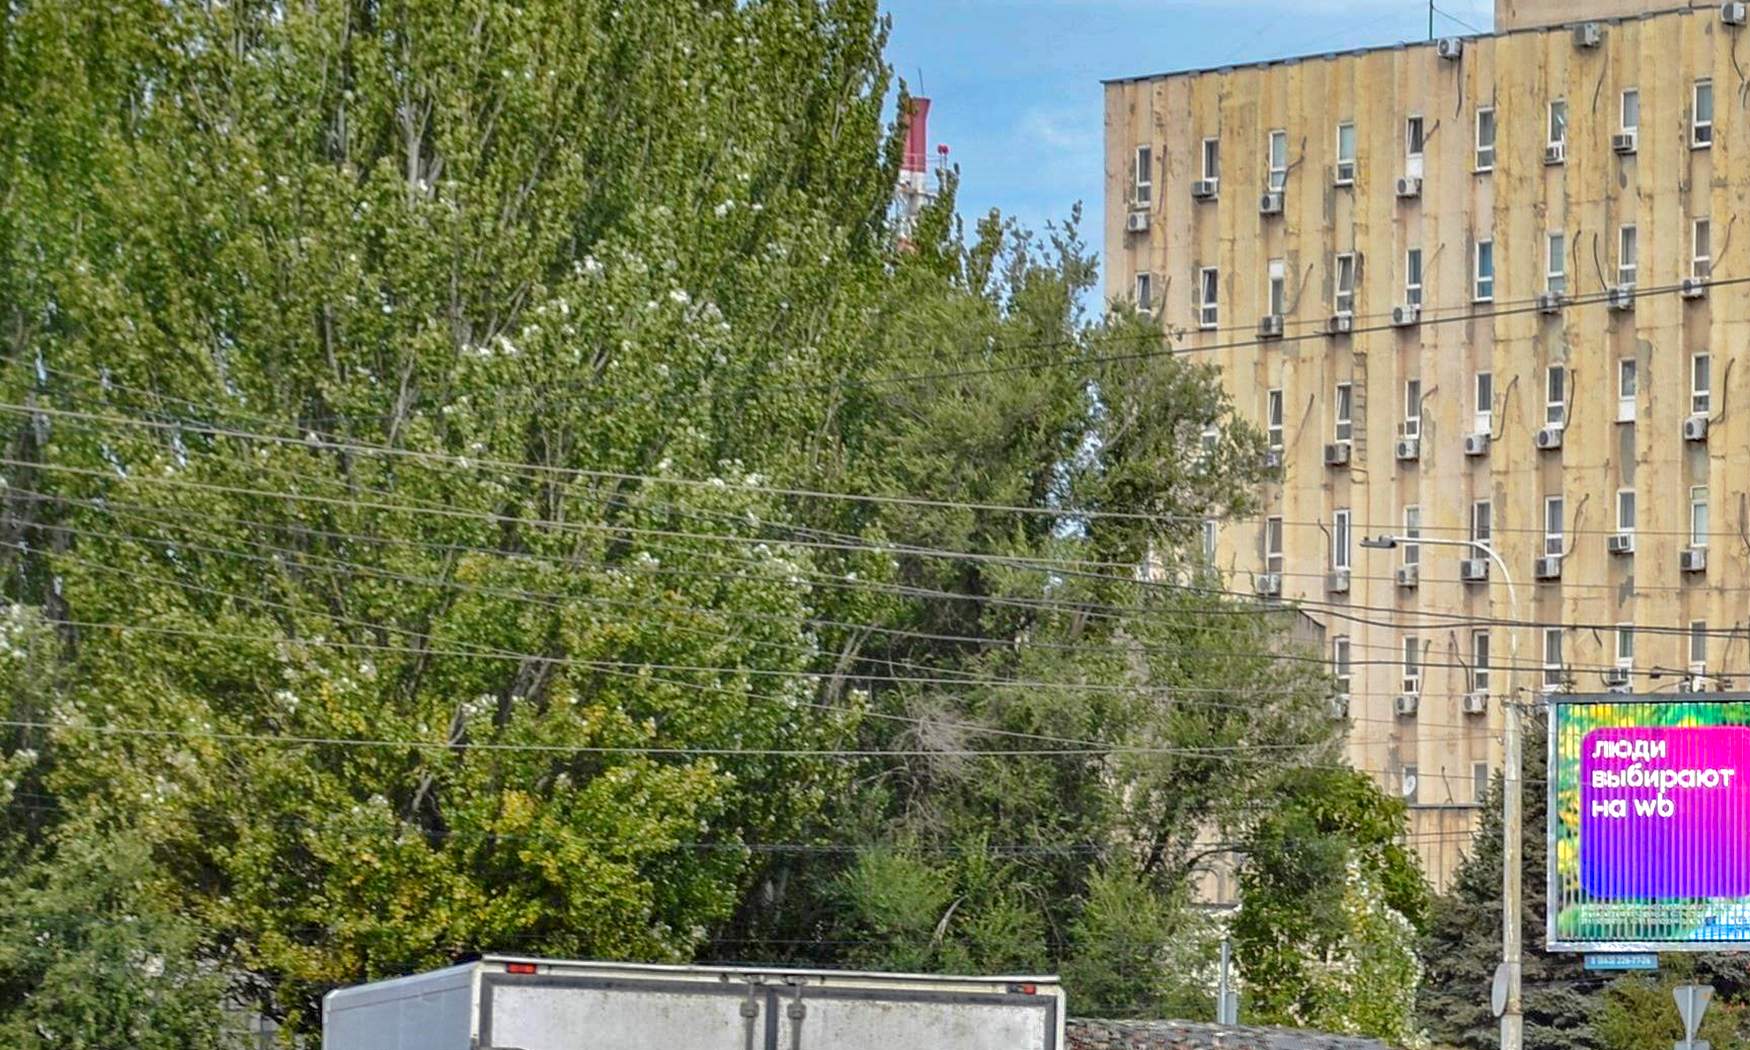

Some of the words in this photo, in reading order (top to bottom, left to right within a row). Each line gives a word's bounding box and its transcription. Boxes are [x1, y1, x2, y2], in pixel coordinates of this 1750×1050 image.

[1592, 739, 1666, 762] люди
[1592, 763, 1734, 793] выбирают
[1592, 799, 1627, 818] на
[1634, 793, 1675, 818] wb
